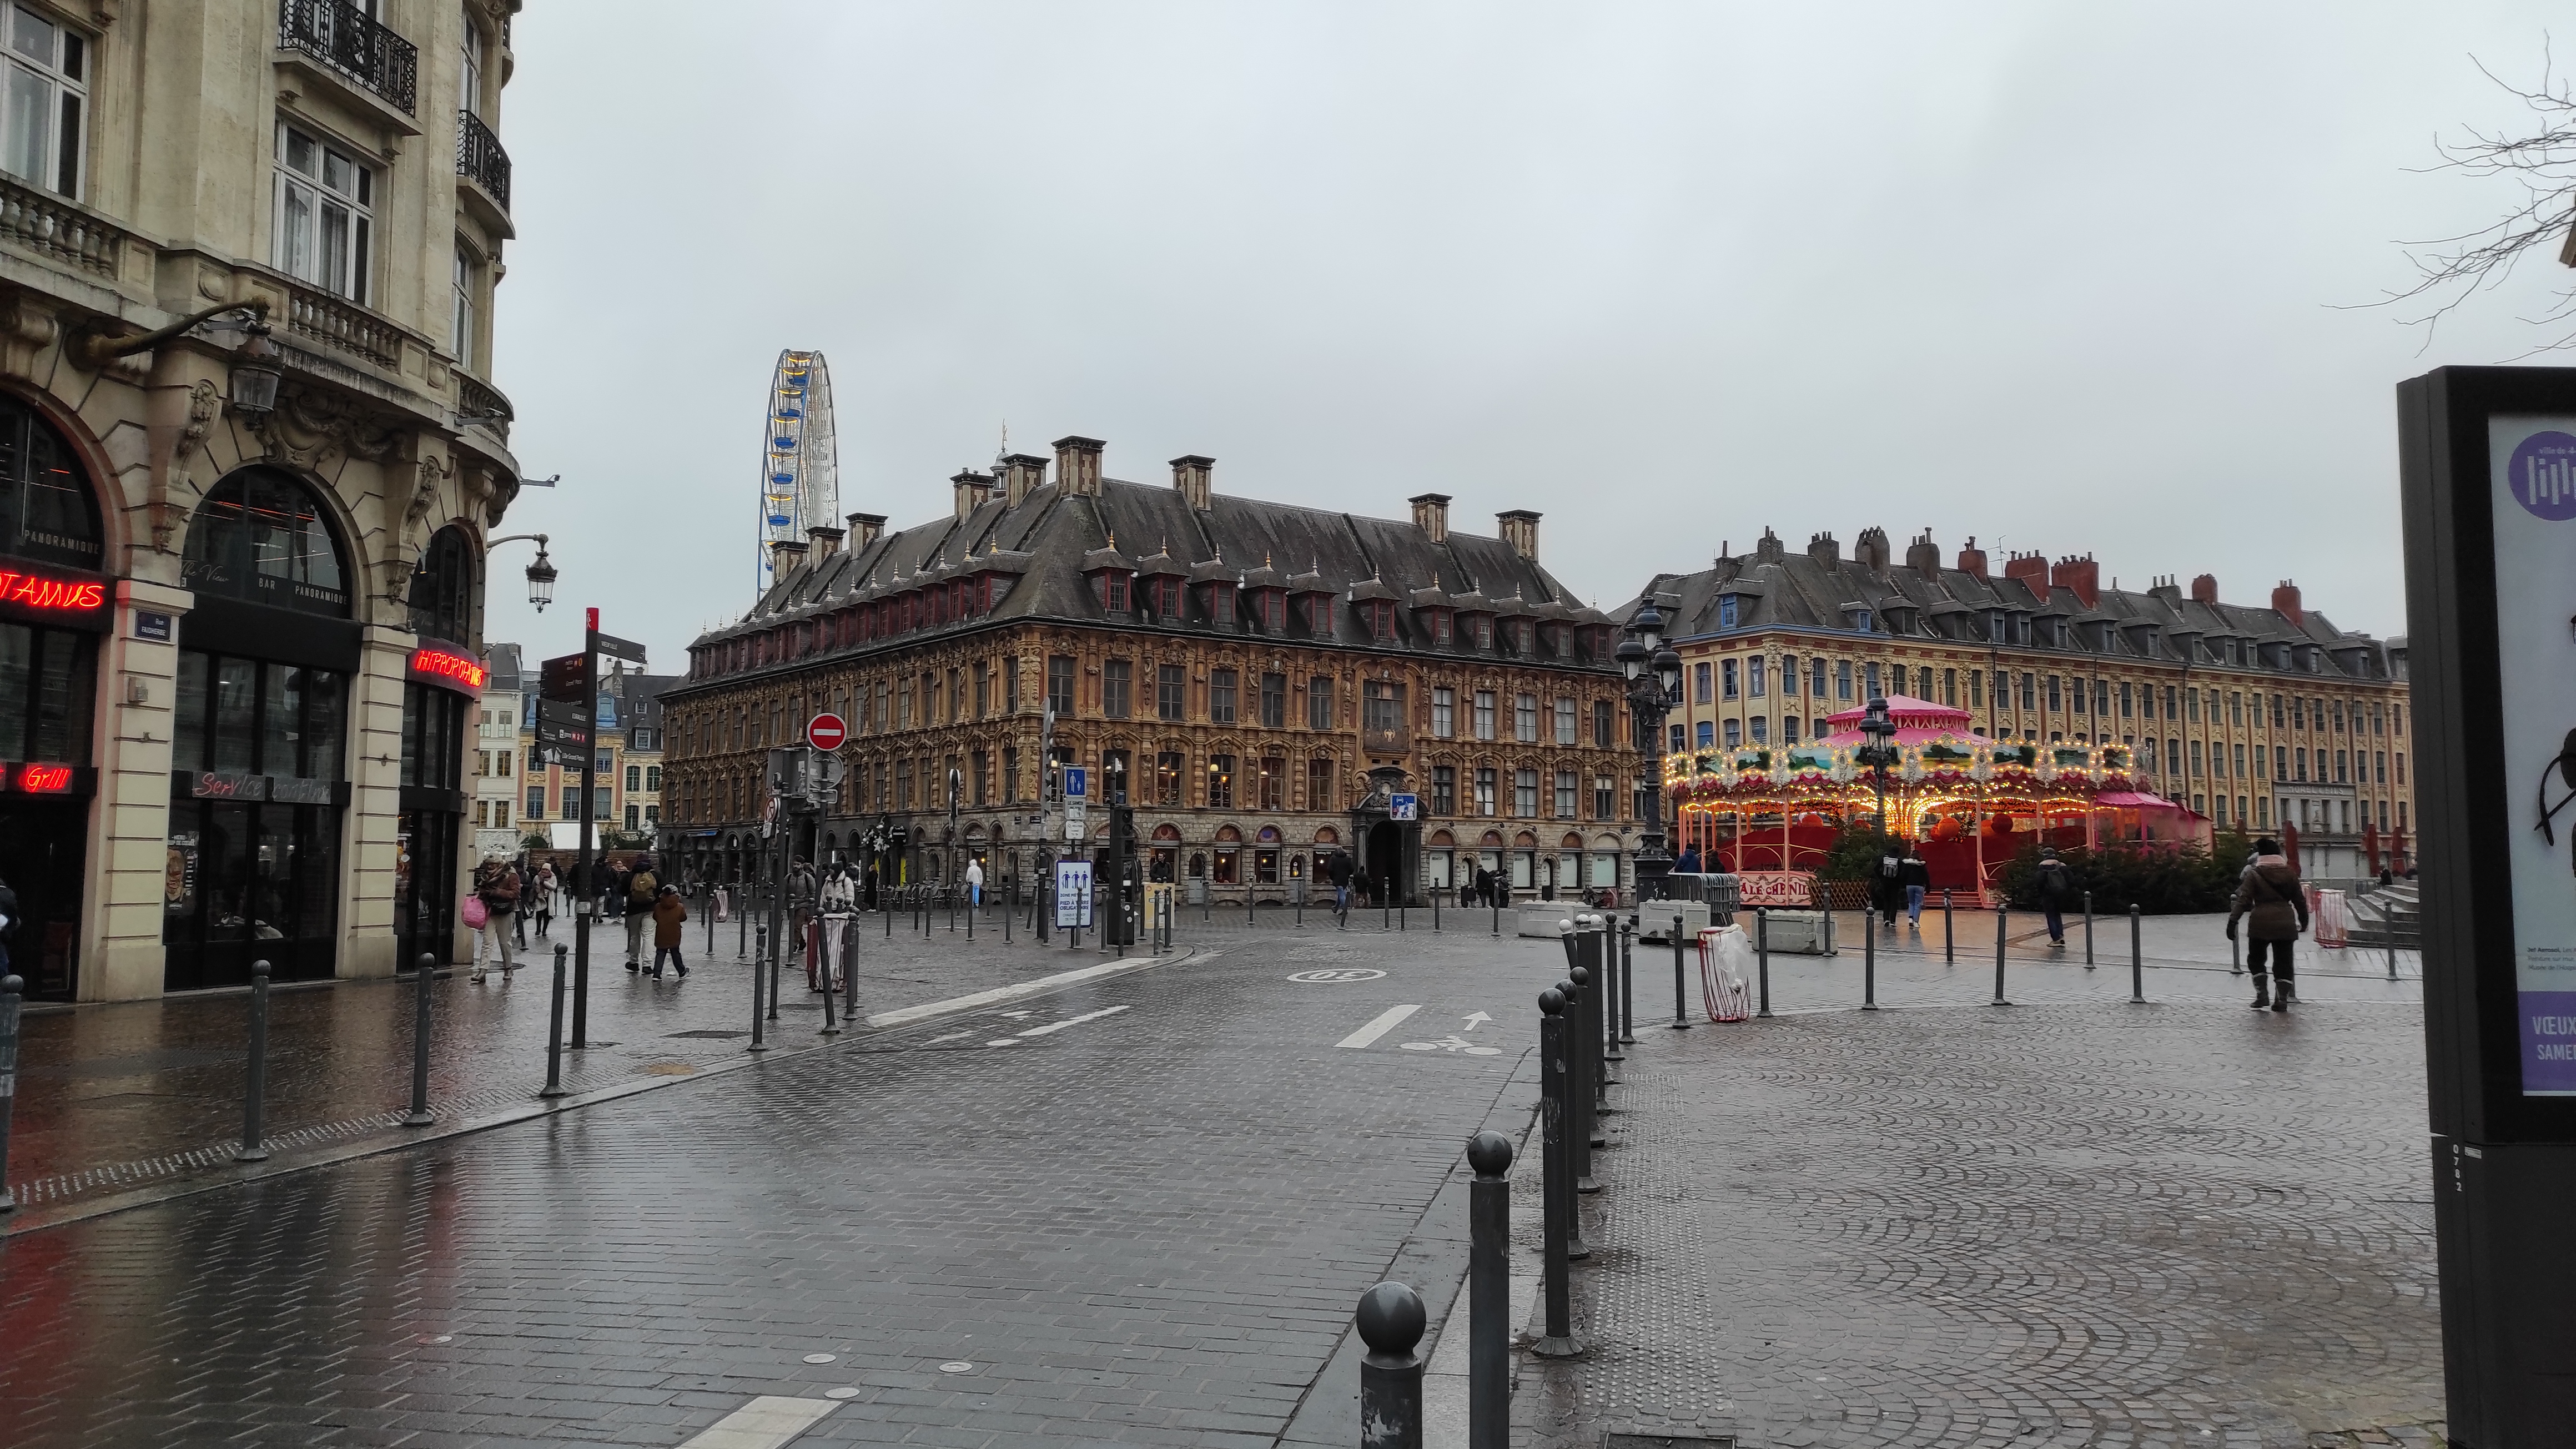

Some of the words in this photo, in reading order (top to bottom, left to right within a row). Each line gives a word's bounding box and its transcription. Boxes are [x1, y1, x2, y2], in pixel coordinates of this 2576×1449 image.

[24, 529, 99, 555] PANORAMIQUE
[199, 564, 229, 582] View
[0, 572, 106, 607] TAMUS
[258, 577, 275, 590] BAR
[295, 585, 348, 605] PANORAMIQUE
[416, 650, 485, 686] HIPPOPOTAMUS
[28, 767, 68, 792] Grill
[192, 773, 262, 796] Service
[2532, 1016, 2576, 1035] VŒUX
